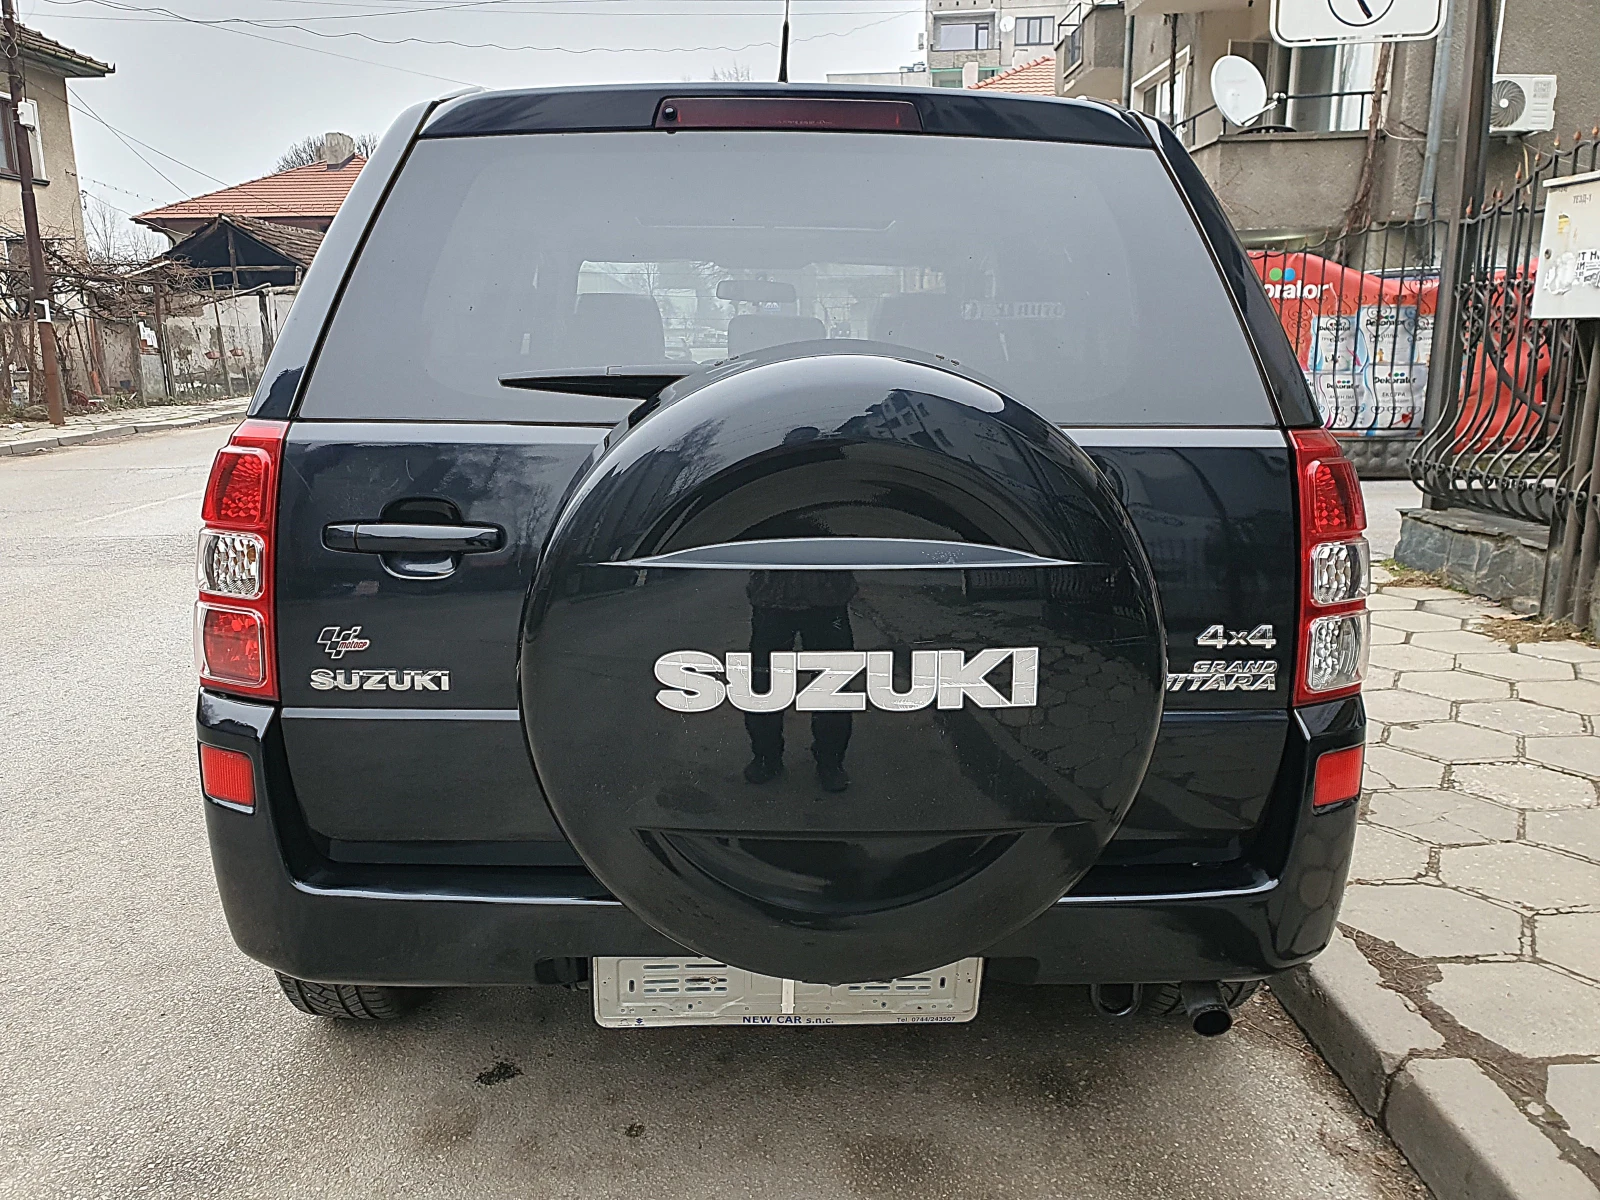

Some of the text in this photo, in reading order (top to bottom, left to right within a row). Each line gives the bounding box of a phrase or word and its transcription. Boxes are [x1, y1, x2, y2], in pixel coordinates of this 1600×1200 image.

[1366, 318, 1406, 326] Deoraor
[1197, 625, 1276, 648] 4x4
[1193, 660, 1278, 673] GRAND
[310, 669, 450, 691] SUZUKI
[654, 647, 1039, 712] SUZUKI
[742, 1015, 772, 1024] NEW
[776, 1015, 802, 1024] CAR
